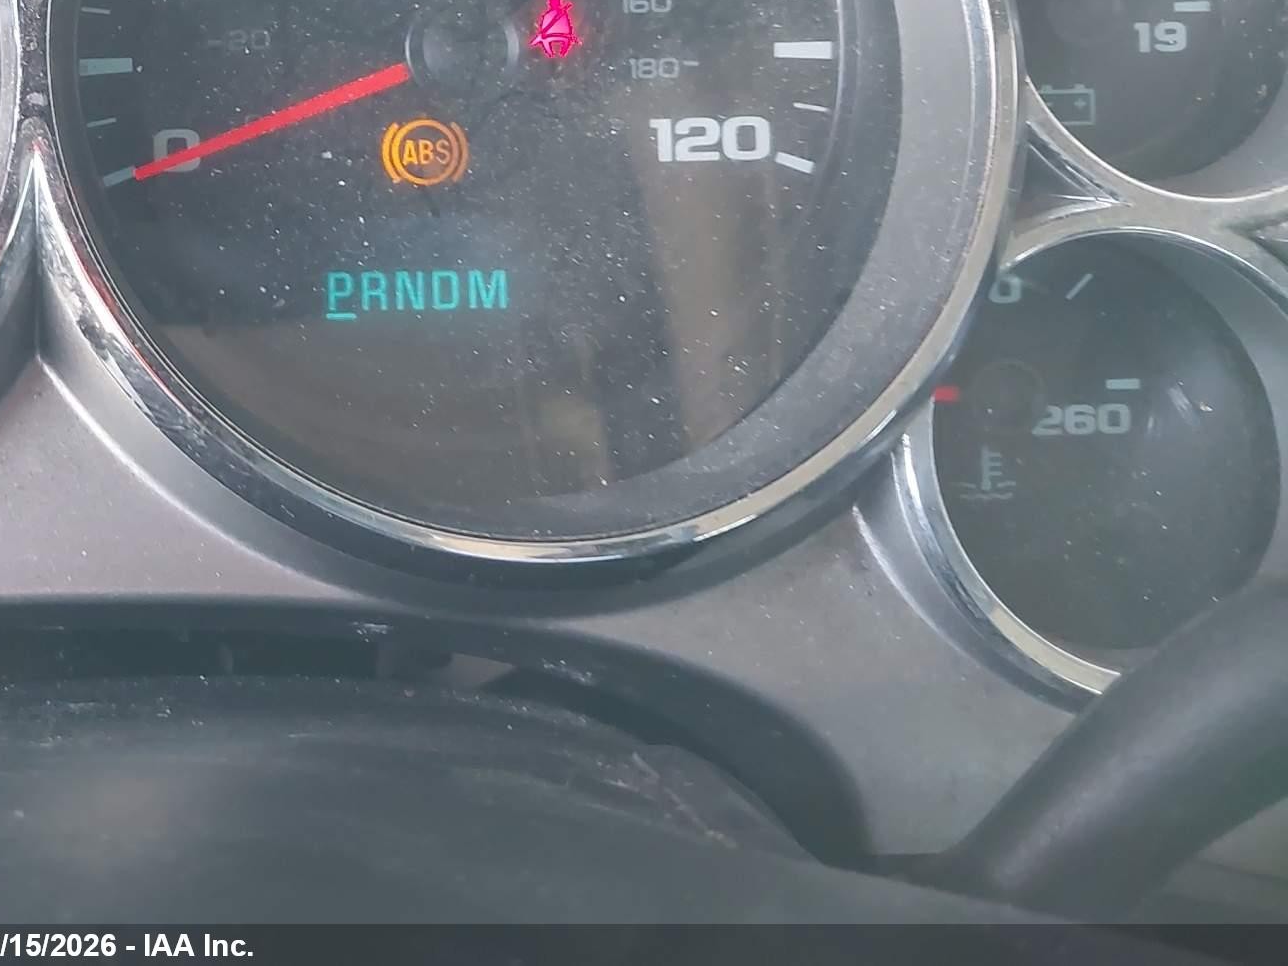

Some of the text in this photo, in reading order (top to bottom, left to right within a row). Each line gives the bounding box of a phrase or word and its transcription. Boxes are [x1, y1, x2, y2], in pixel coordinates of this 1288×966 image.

[228, 30, 271, 50] 20
[1134, 22, 1187, 53] 19
[629, 58, 680, 79] 180
[153, 128, 201, 172] 0
[402, 139, 450, 165] ABS
[649, 116, 771, 162] 120
[327, 269, 508, 311] PRNDM
[1031, 404, 1131, 436] 260
